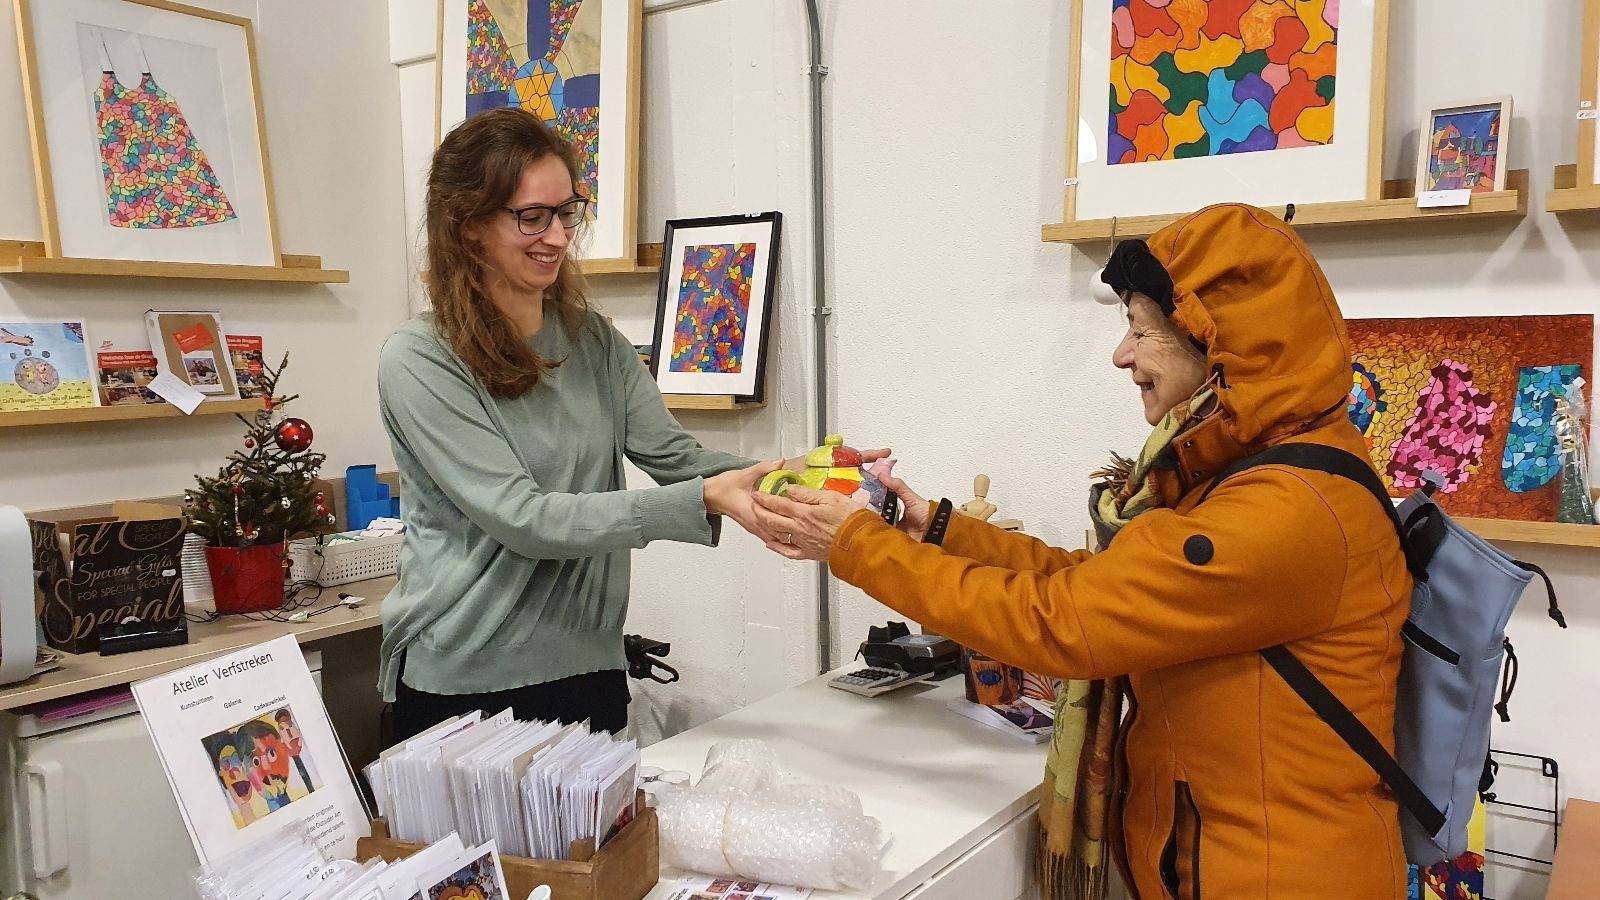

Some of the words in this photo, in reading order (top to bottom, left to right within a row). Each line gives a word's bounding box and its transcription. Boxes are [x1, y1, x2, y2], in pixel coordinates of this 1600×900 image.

[71, 560, 134, 587] Special
[137, 553, 173, 581] Gifts
[77, 590, 98, 601] FOR
[100, 583, 136, 597] SPECIAL
[138, 576, 173, 591] PEOPLE
[46, 577, 183, 644] Special
[172, 673, 209, 696] Atelier
[212, 652, 274, 680] Verfstreken
[223, 697, 242, 709] Galerie
